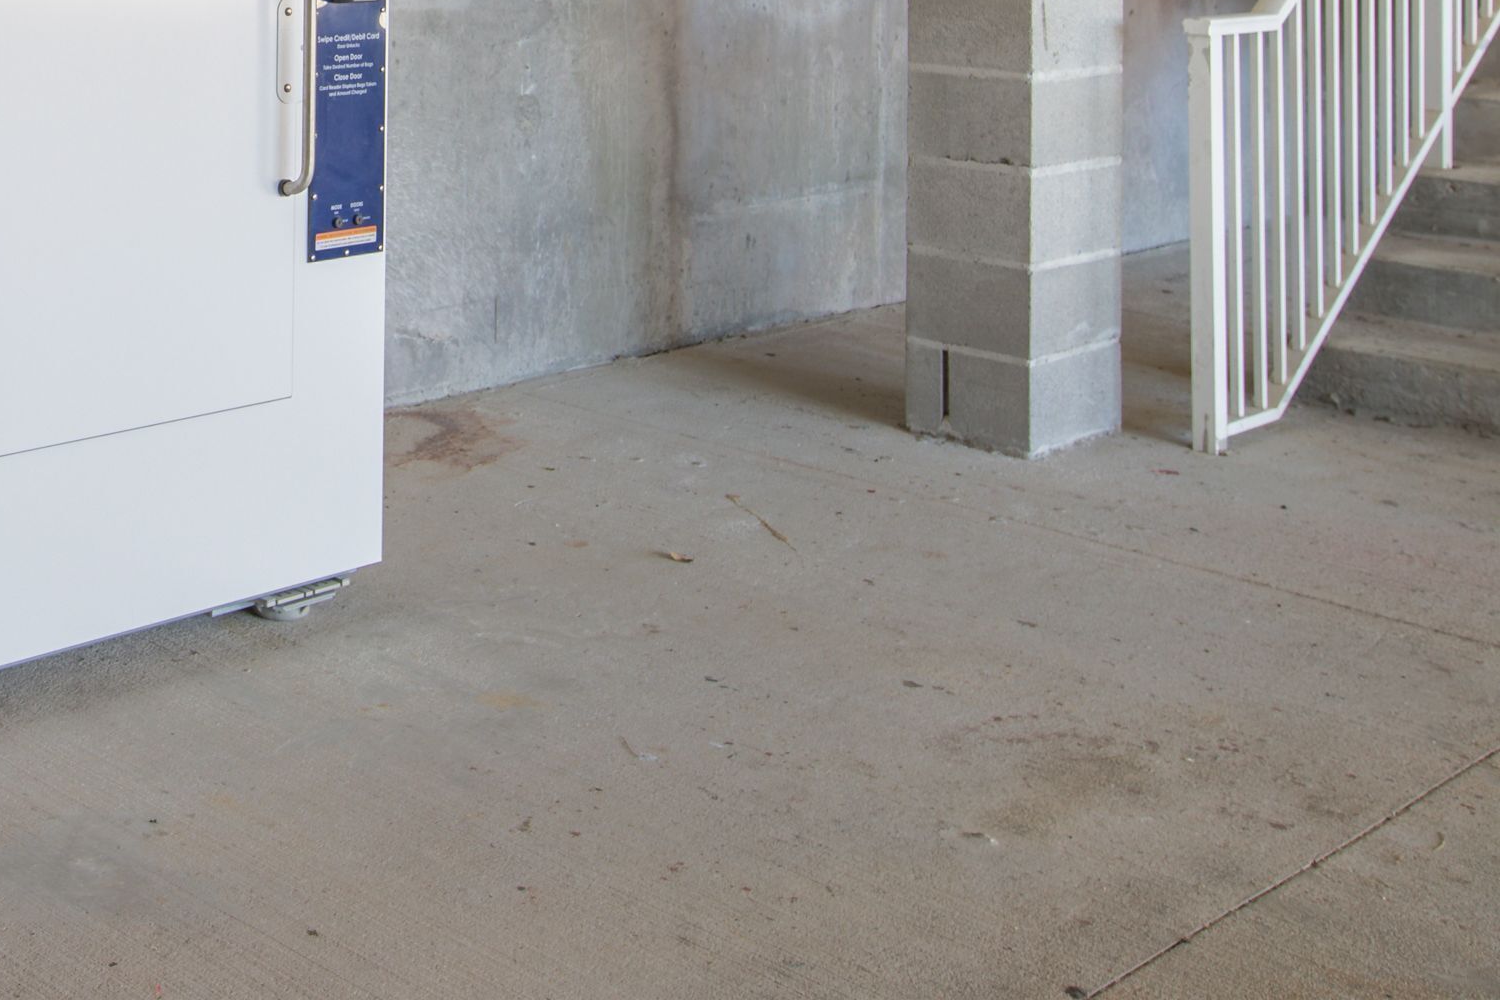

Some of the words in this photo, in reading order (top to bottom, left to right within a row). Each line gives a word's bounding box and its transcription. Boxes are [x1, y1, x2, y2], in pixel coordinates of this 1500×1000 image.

[366, 32, 380, 40] Card
[334, 54, 350, 63] Open
[334, 73, 349, 81] Close
[350, 72, 363, 80] Door
